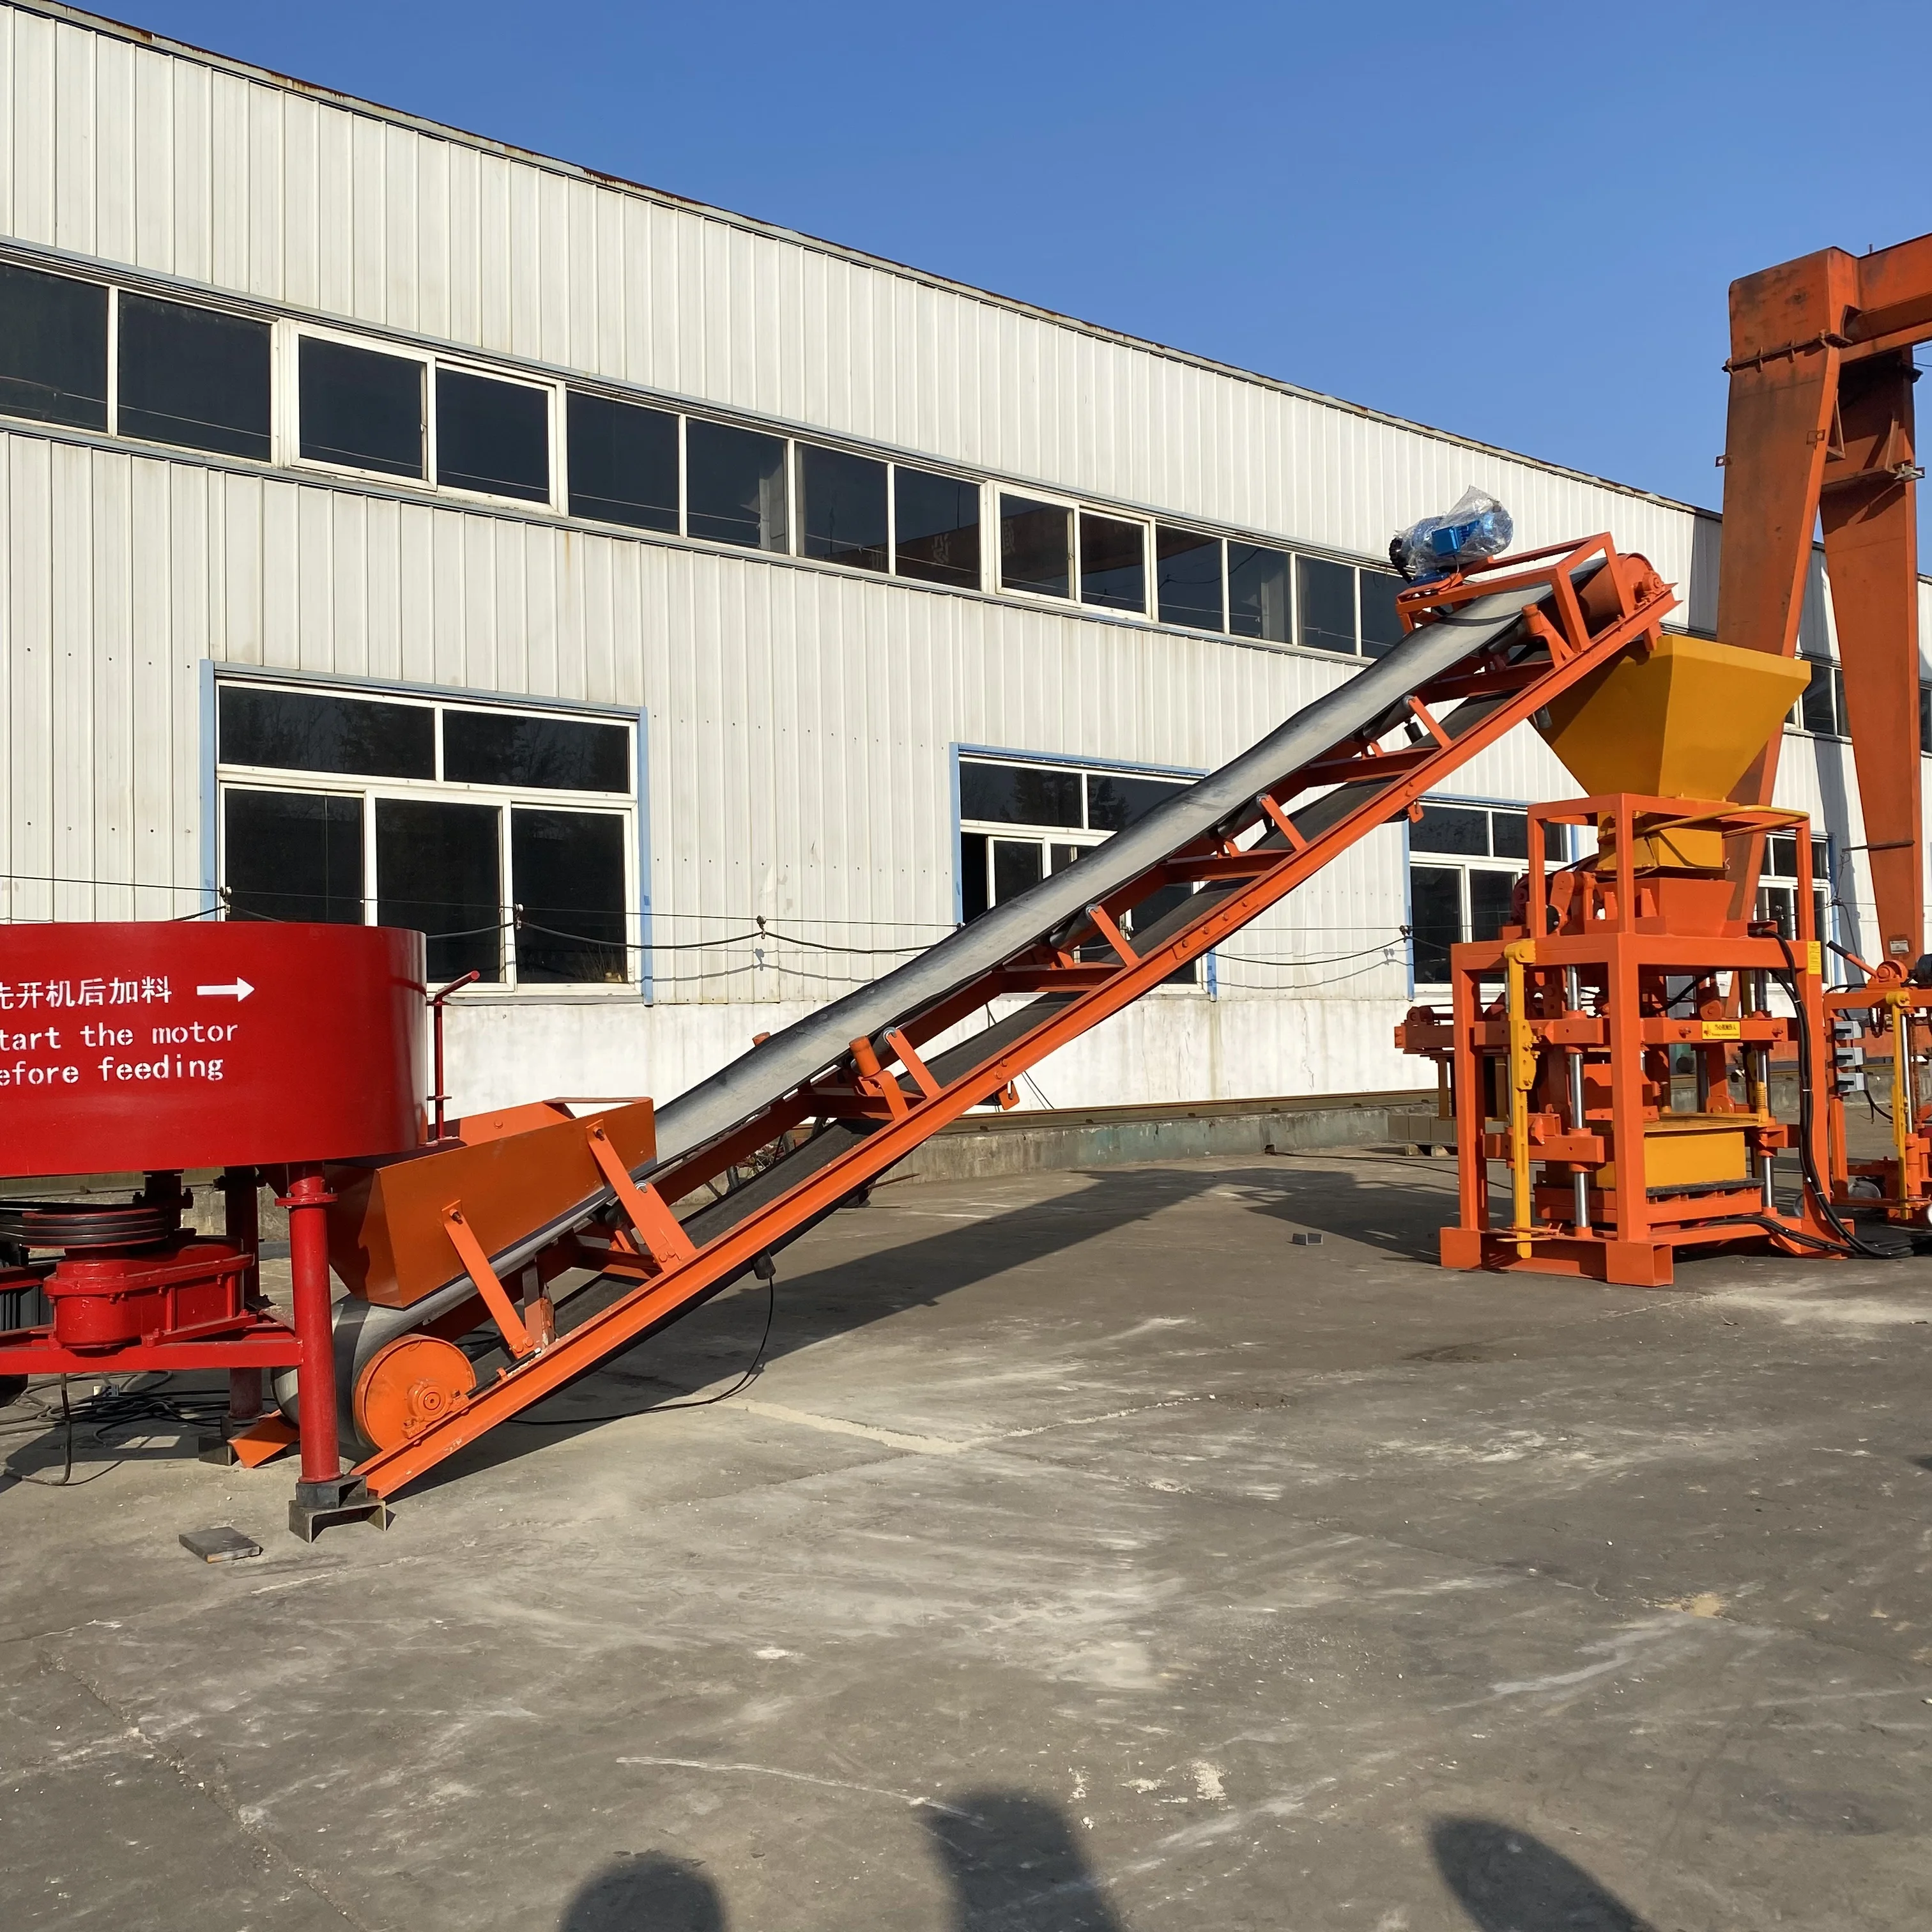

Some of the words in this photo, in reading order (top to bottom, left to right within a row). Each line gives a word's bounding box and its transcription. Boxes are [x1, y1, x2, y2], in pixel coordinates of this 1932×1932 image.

[0, 1027, 61, 1051] tart
[80, 1022, 133, 1046] the
[152, 1021, 238, 1044] motor
[0, 1061, 79, 1086] efore
[98, 1054, 223, 1081] feeding
